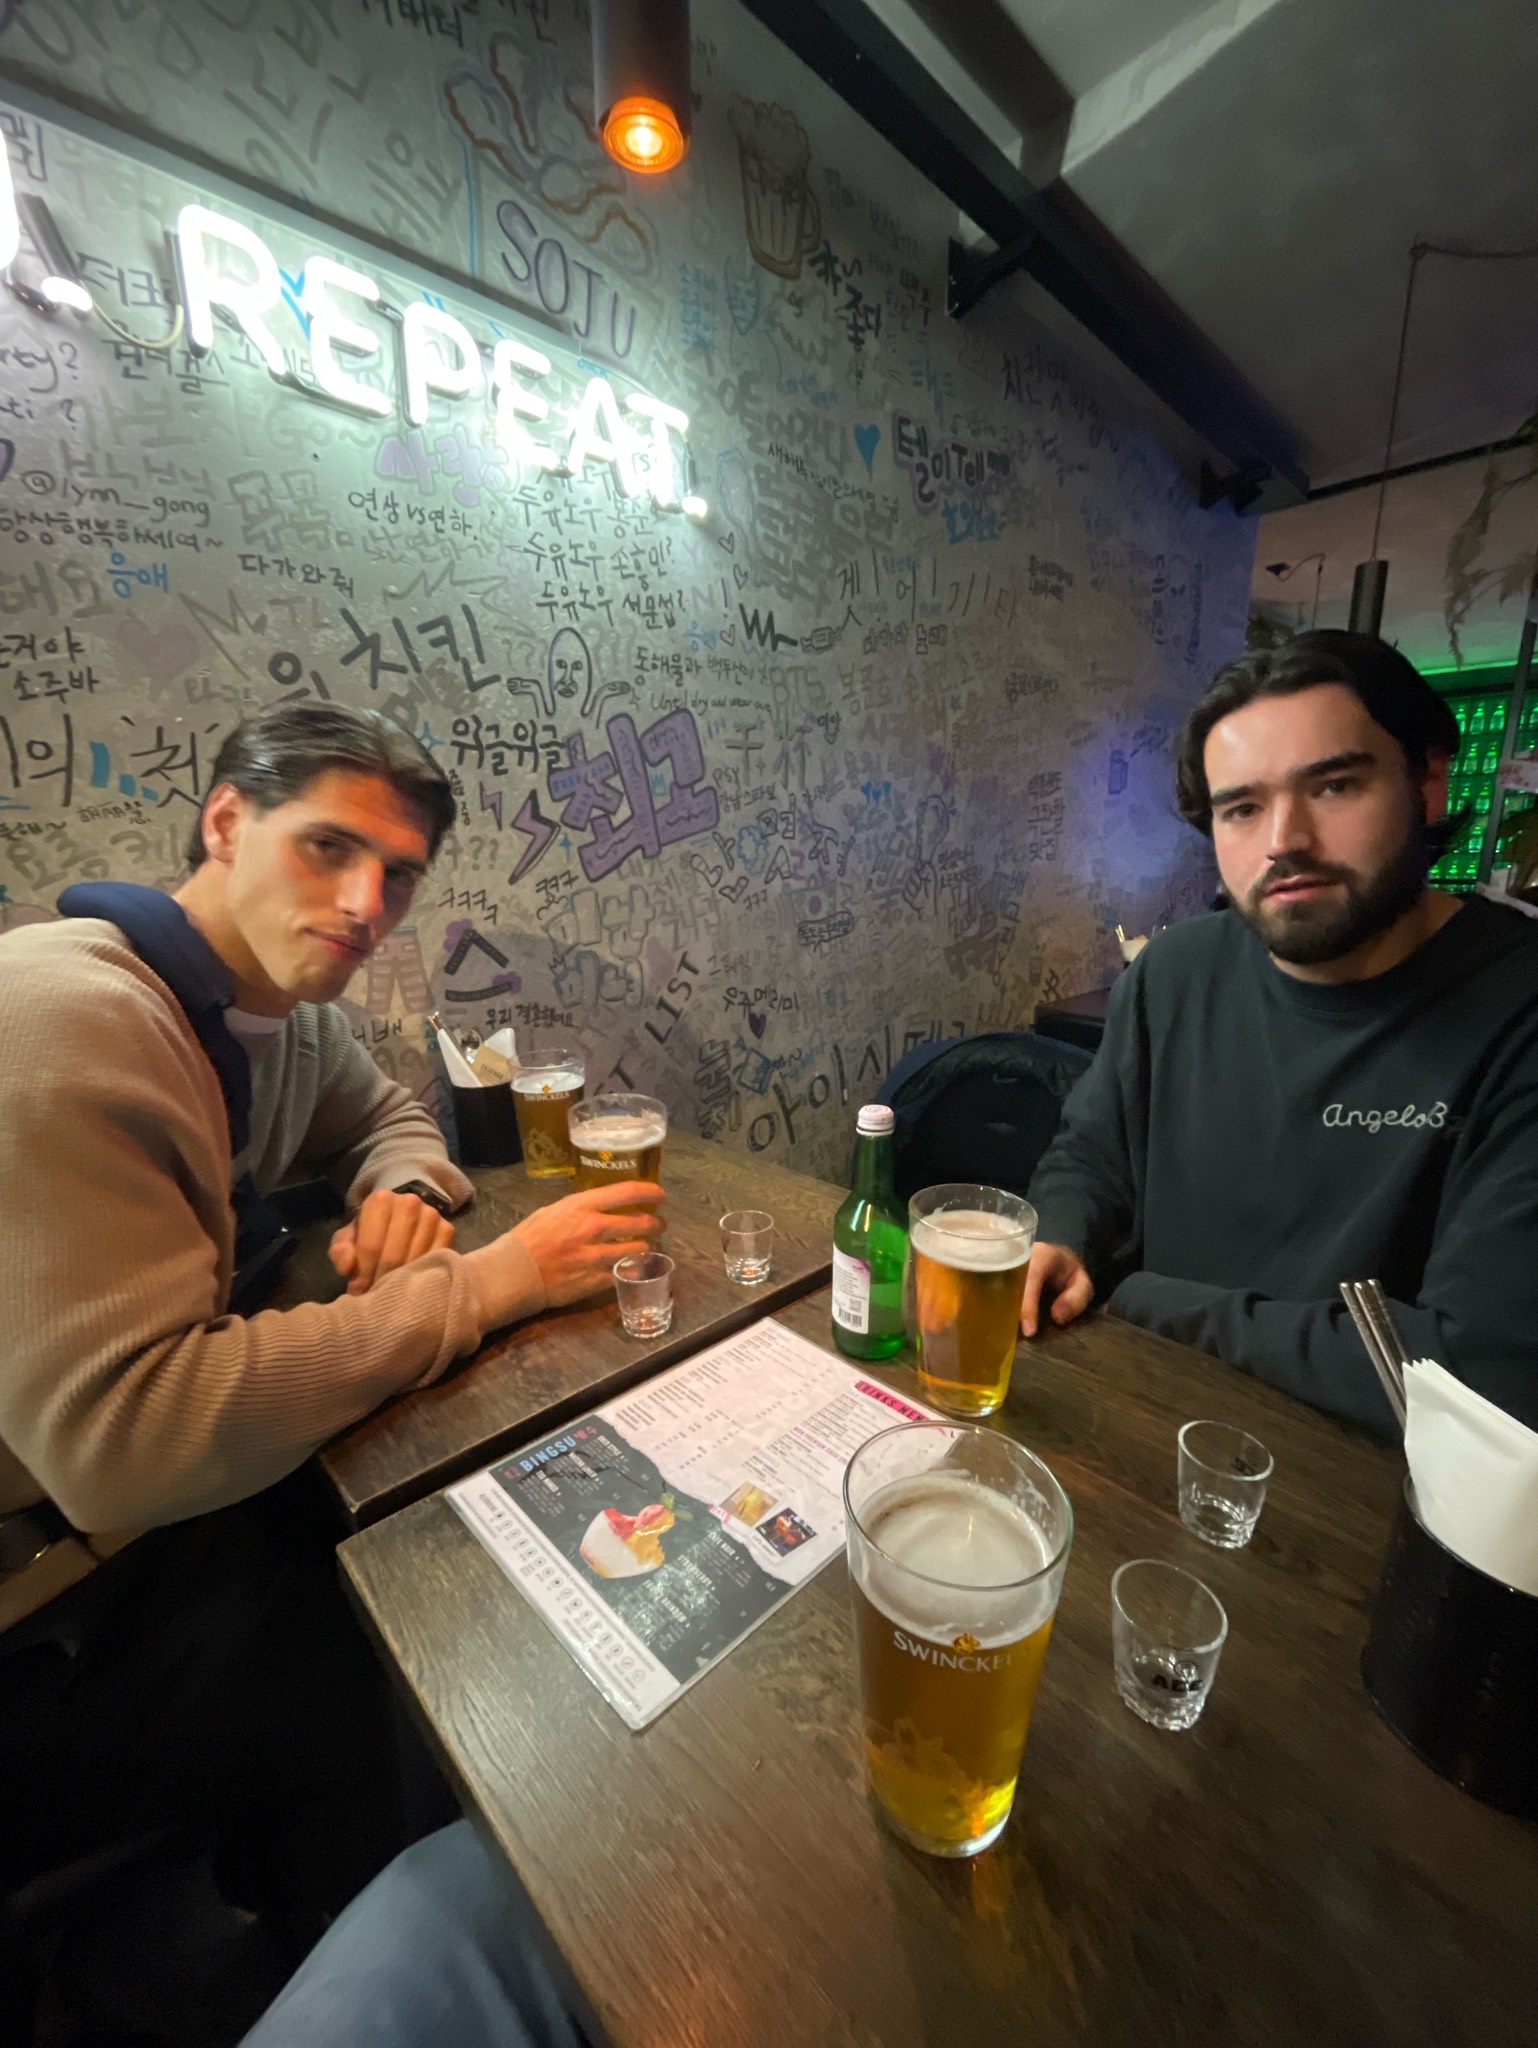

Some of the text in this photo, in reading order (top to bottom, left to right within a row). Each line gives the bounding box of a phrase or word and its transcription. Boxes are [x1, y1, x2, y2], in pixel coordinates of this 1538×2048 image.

[496, 200, 635, 358] SOJU
[105, 551, 169, 599] 응애
[14, 666, 100, 704] 소주바
[339, 603, 502, 692] 치킨
[547, 708, 721, 883] 최고
[644, 950, 700, 1044] LIST
[519, 1435, 577, 1474] BINGSU
